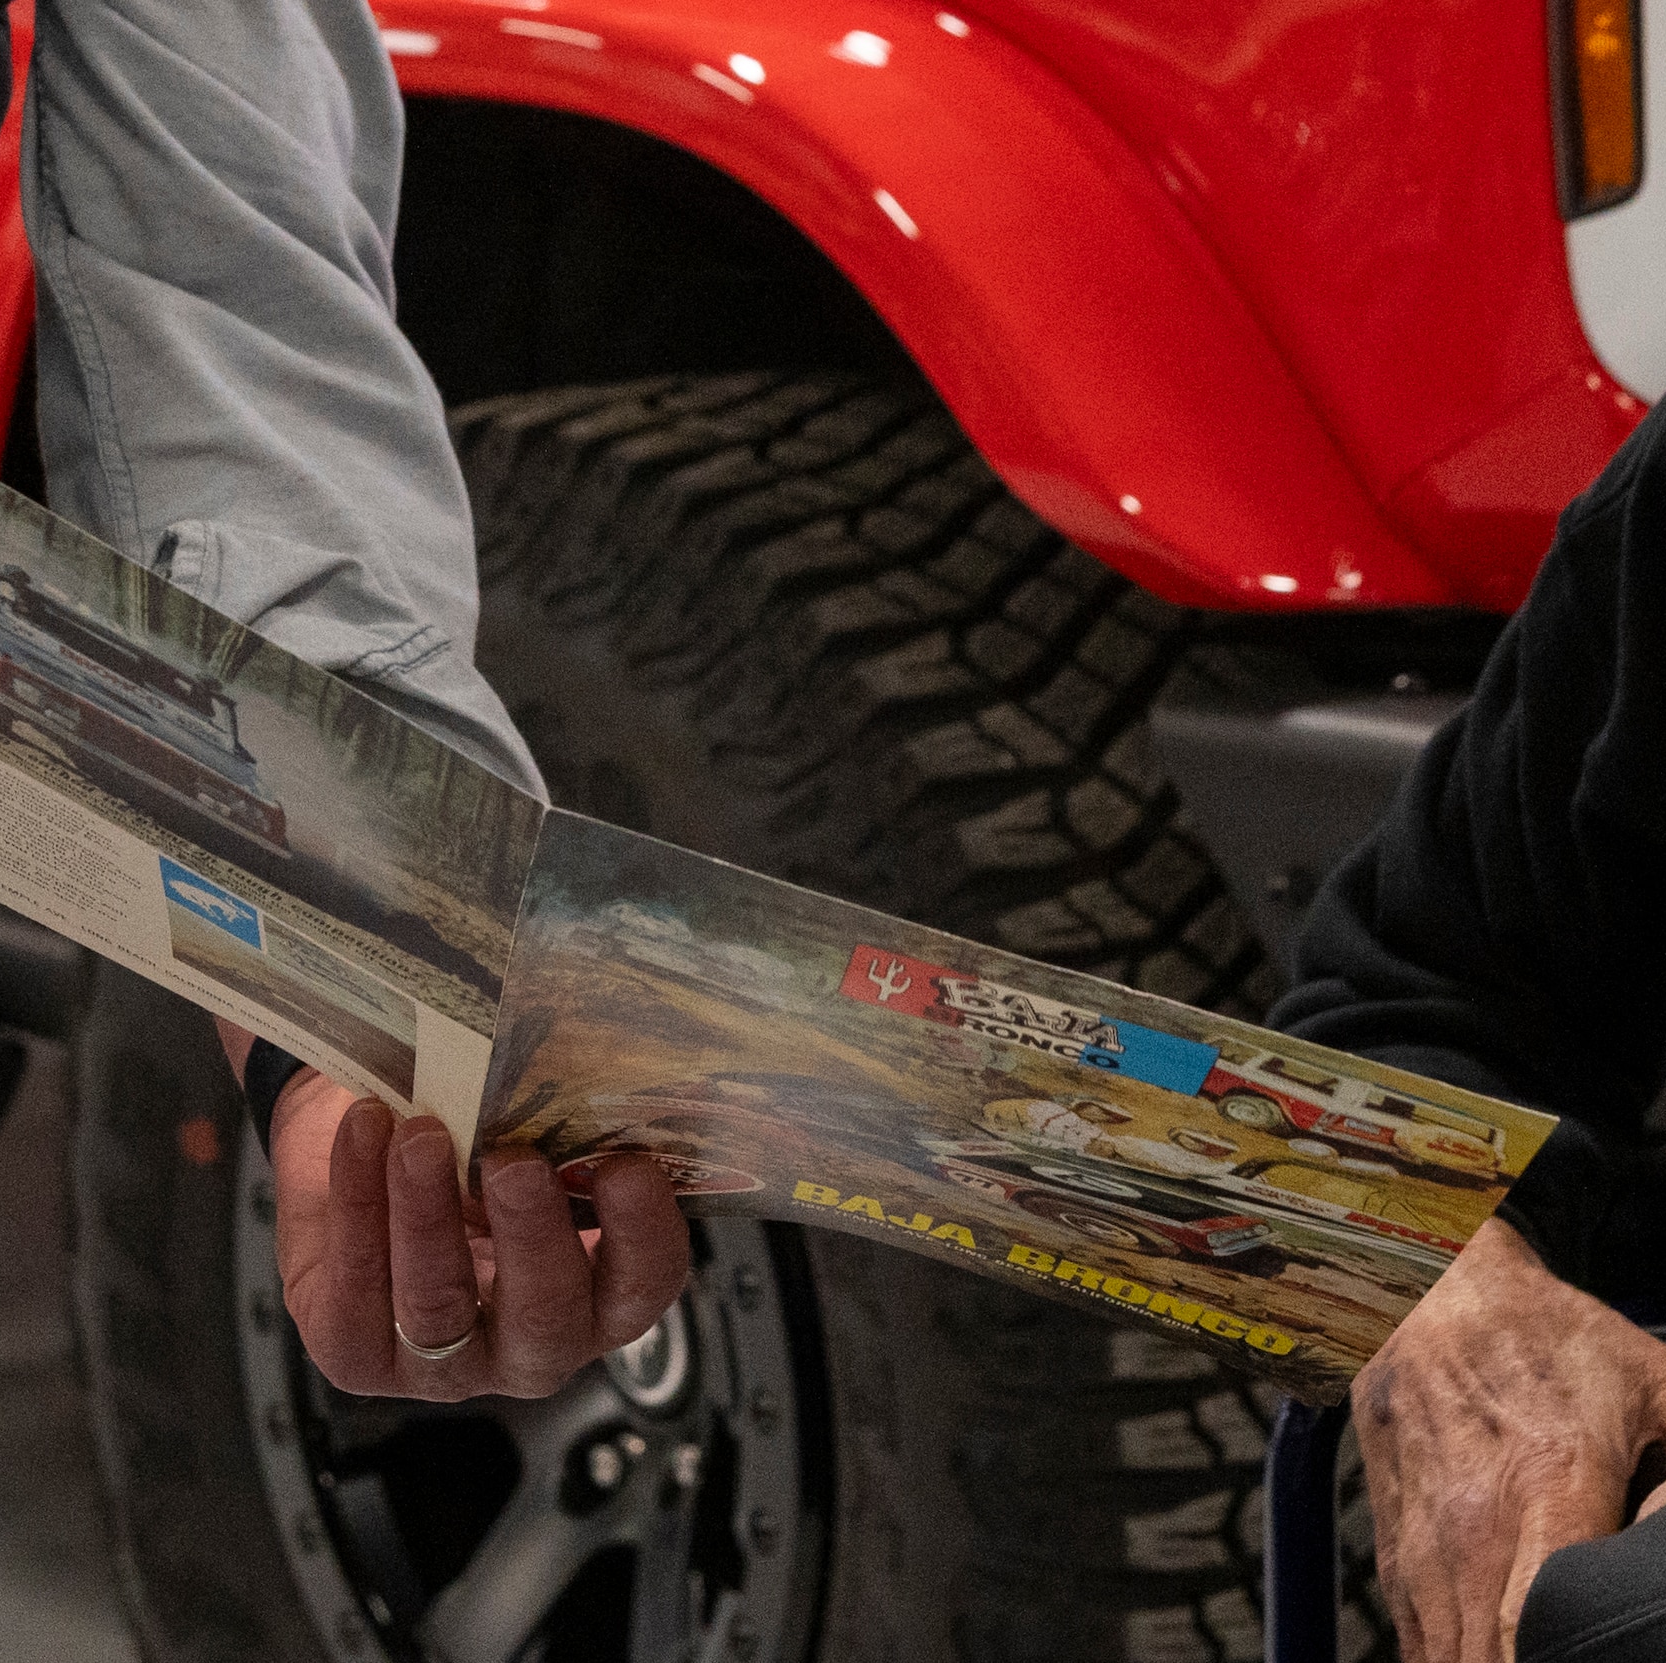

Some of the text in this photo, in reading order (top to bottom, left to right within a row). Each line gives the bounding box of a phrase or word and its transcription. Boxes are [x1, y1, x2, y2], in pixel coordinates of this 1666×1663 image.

[925, 1004, 1120, 1070] BRONCO
[934, 977, 1126, 1052] BAJA
[791, 1180, 976, 1250] BAJA
[1006, 1243, 1294, 1356] BRONCO
